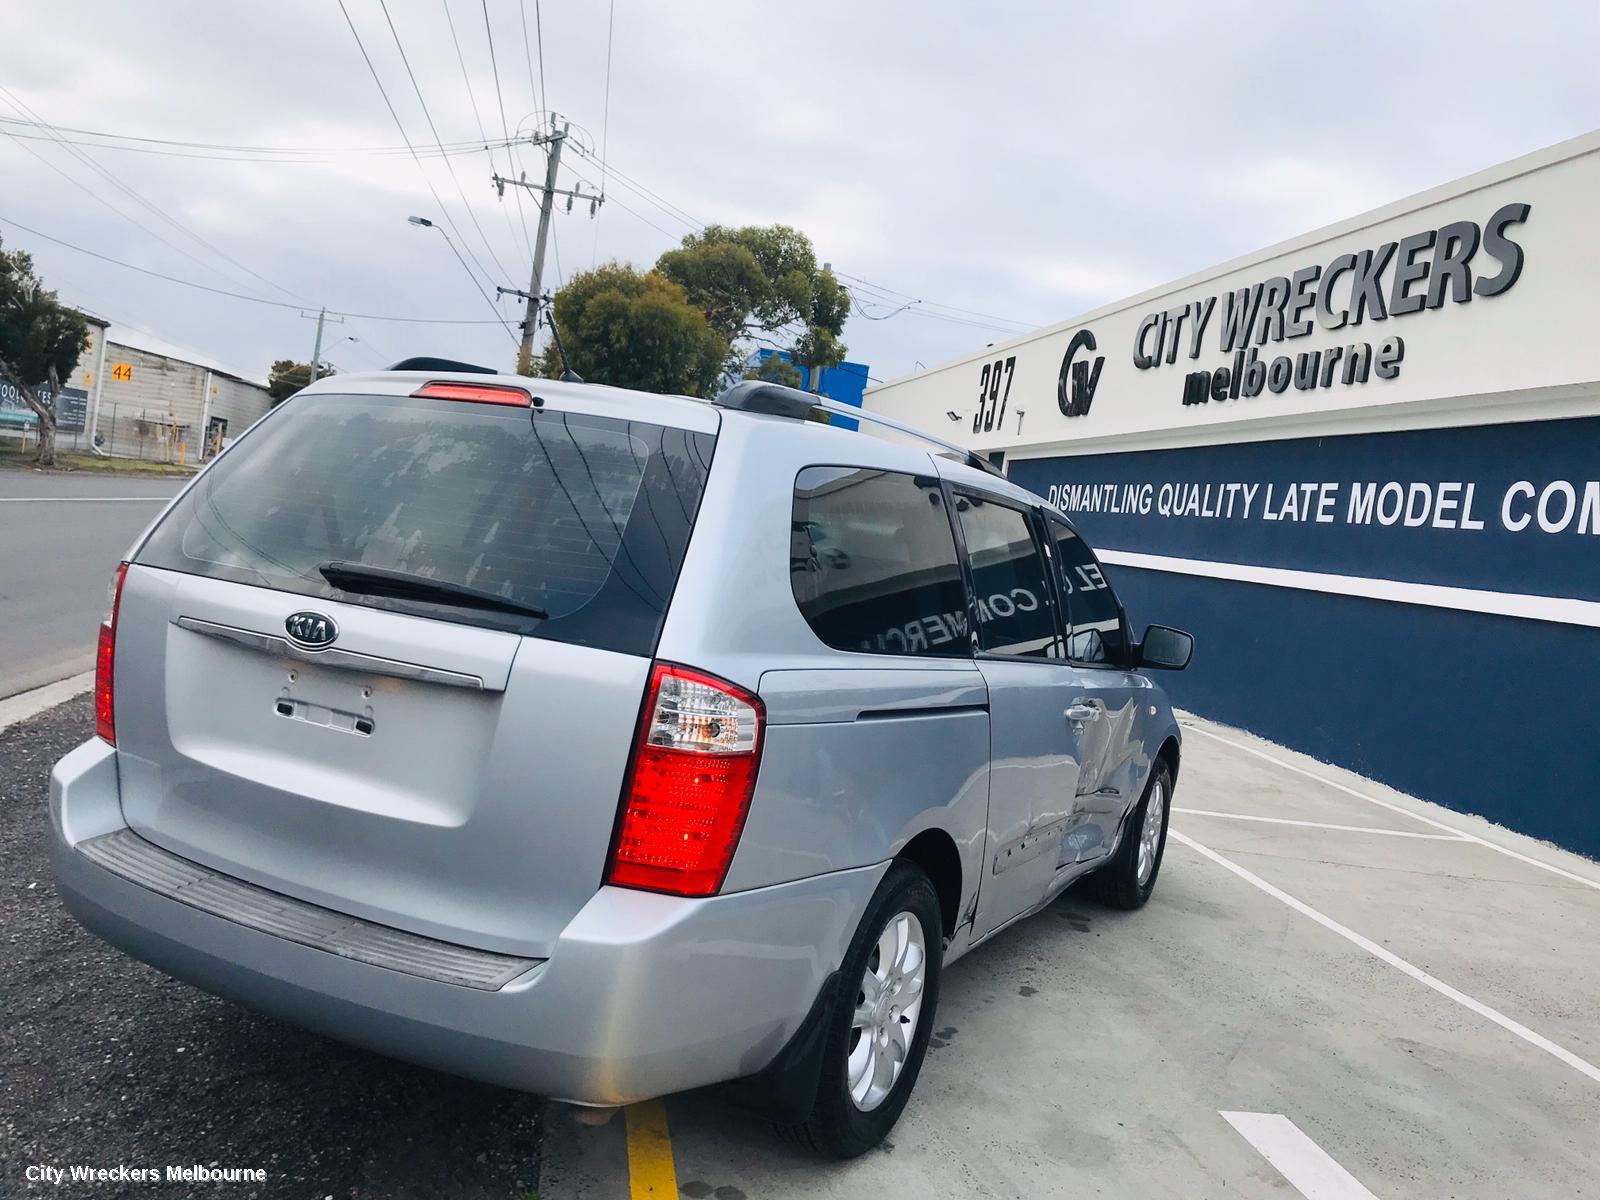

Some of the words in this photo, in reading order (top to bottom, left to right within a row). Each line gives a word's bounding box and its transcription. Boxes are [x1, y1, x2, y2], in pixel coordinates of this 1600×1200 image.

[1133, 296, 1217, 370] CITY
[1220, 202, 1532, 353] WRECKERS
[112, 364, 132, 381] 44
[972, 355, 1017, 434] 397
[1182, 335, 1405, 406] melbourne
[1048, 483, 1153, 515] DISMANTLING
[1157, 483, 1259, 520] QUALITY
[1262, 482, 1339, 523] LATE
[1346, 481, 1485, 530] MODEL
[290, 616, 327, 640] KIA
